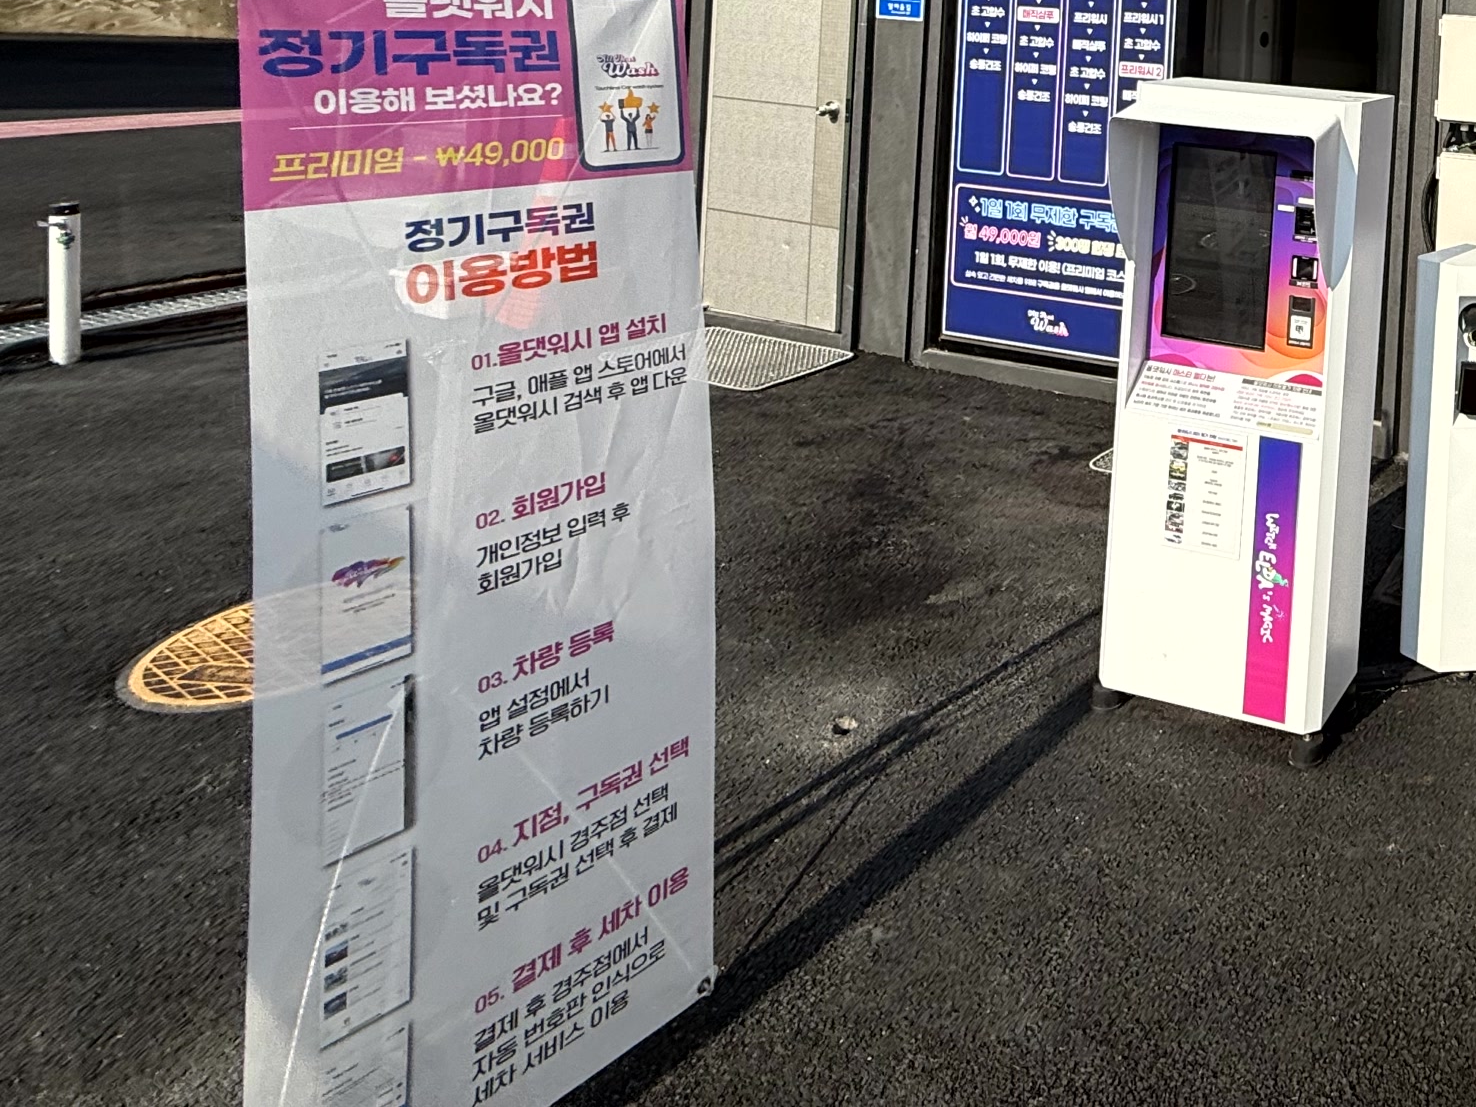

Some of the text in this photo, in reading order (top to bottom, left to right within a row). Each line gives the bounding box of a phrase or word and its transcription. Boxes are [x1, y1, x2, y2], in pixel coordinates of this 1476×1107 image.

[1158, 14, 1165, 25] 1
[258, 29, 561, 77] 정기구독권
[601, 62, 659, 78] Wash
[1120, 64, 1162, 77] 프리워시 2
[314, 83, 563, 115] 이용해 보셨나요?
[269, 148, 404, 183] 프리미엄
[435, 137, 564, 168] ₩49,000
[404, 202, 595, 253] 정기구독권
[963, 223, 977, 240] 월
[978, 225, 1042, 248] 49,000원
[980, 198, 1004, 217] 1일
[1005, 201, 1028, 221] 1회
[1029, 203, 1078, 228] 무제한
[405, 241, 598, 304] 이용방법
[471, 313, 667, 371] 01.올댓워시 앱 설치
[471, 344, 686, 407] 구글, 애플 앱 스토어에서
[473, 367, 687, 434] 올댓워시 검색 후 앱 다운
[475, 471, 607, 530] 02. 회원가입
[476, 501, 631, 568] 개인정보 입력 후
[476, 549, 562, 596] 회원가입
[1260, 604, 1274, 643] MAGIC
[477, 620, 615, 693] 03. 차량 등록
[478, 684, 609, 760] 차량 등록하기
[479, 667, 590, 732] 앱 설정에서
[477, 736, 690, 863] 04. 지점, 구독권 선택
[476, 782, 669, 904] 올댓워시 경주점 선택
[477, 802, 678, 931] 및 구독권 선택 후 결제
[475, 866, 689, 1014] 05. 결제 후 세차 이용
[472, 939, 666, 1082] 자동 번호판 인식으로
[474, 926, 649, 1054] 결제 후 경주점에서
[471, 989, 630, 1107] 세차 서비스 이용
